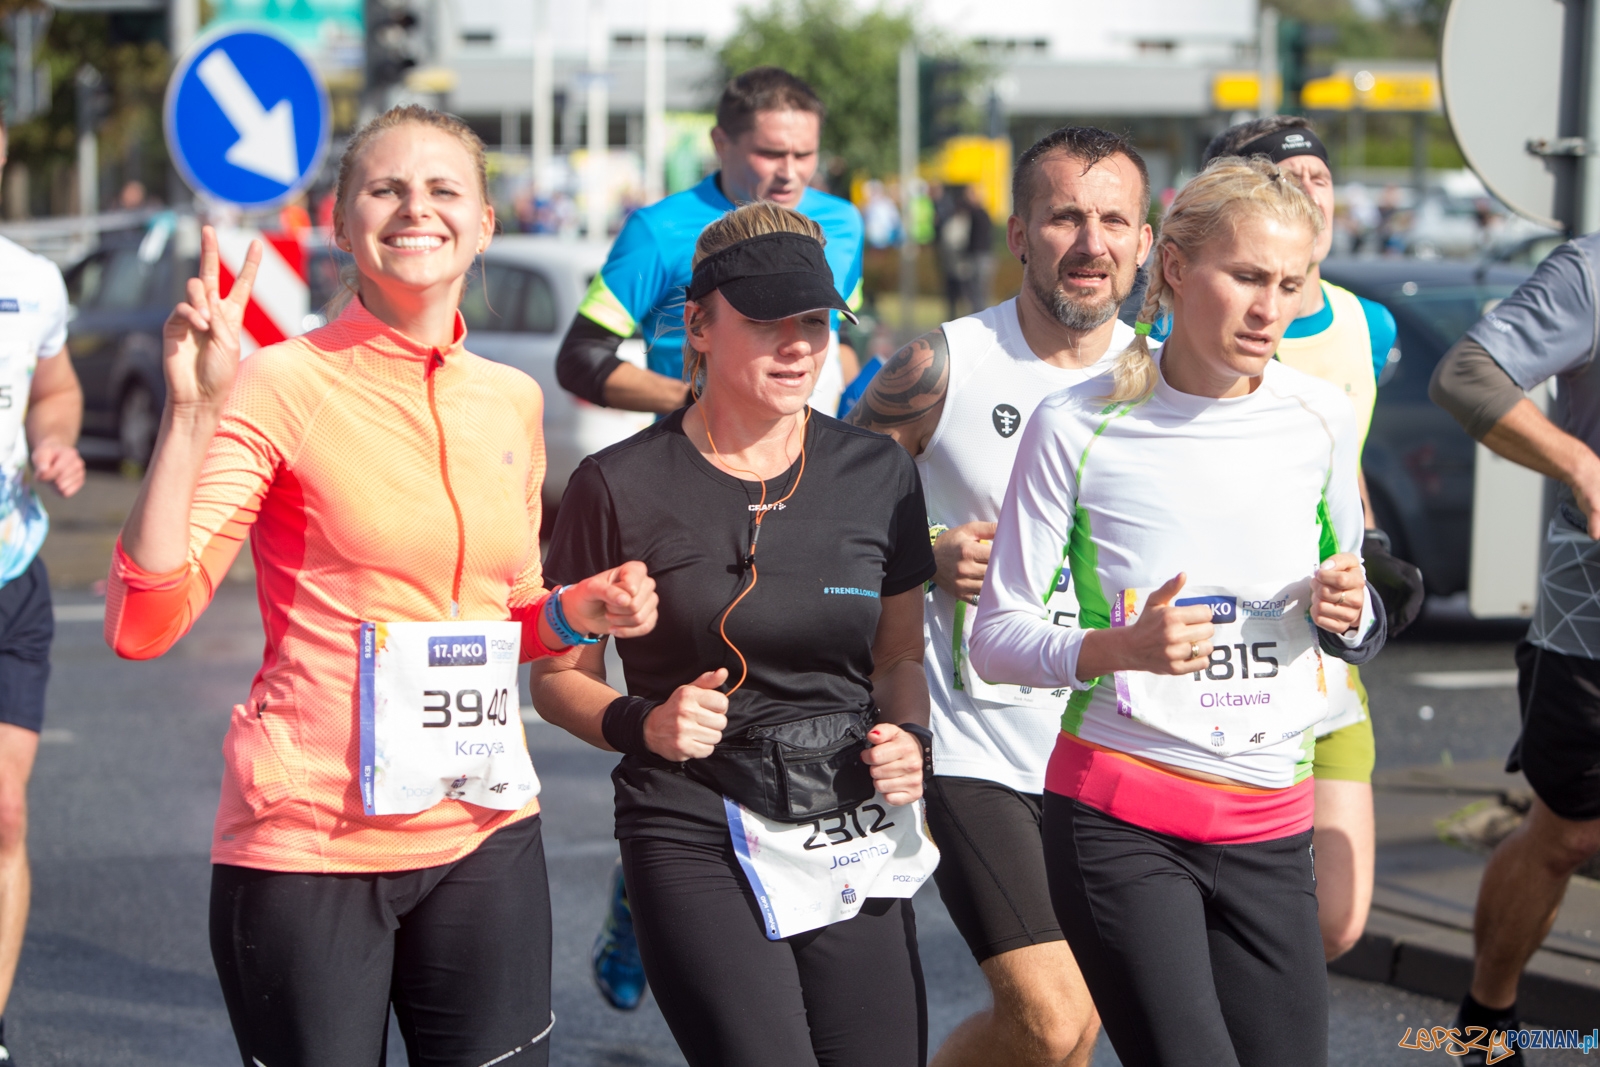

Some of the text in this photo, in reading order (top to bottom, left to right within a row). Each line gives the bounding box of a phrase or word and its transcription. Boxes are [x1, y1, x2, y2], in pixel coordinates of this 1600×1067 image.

[748, 503, 778, 511] CRAFT
[433, 643, 482, 659] 17.PKO
[1050, 688, 1068, 698] 4F
[1200, 691, 1271, 708] Oktawia
[422, 688, 508, 728] 3940
[1249, 732, 1266, 743] 4F
[489, 783, 509, 794] 4F
[797, 803, 895, 851] 2312
[830, 842, 889, 870] Joanna
